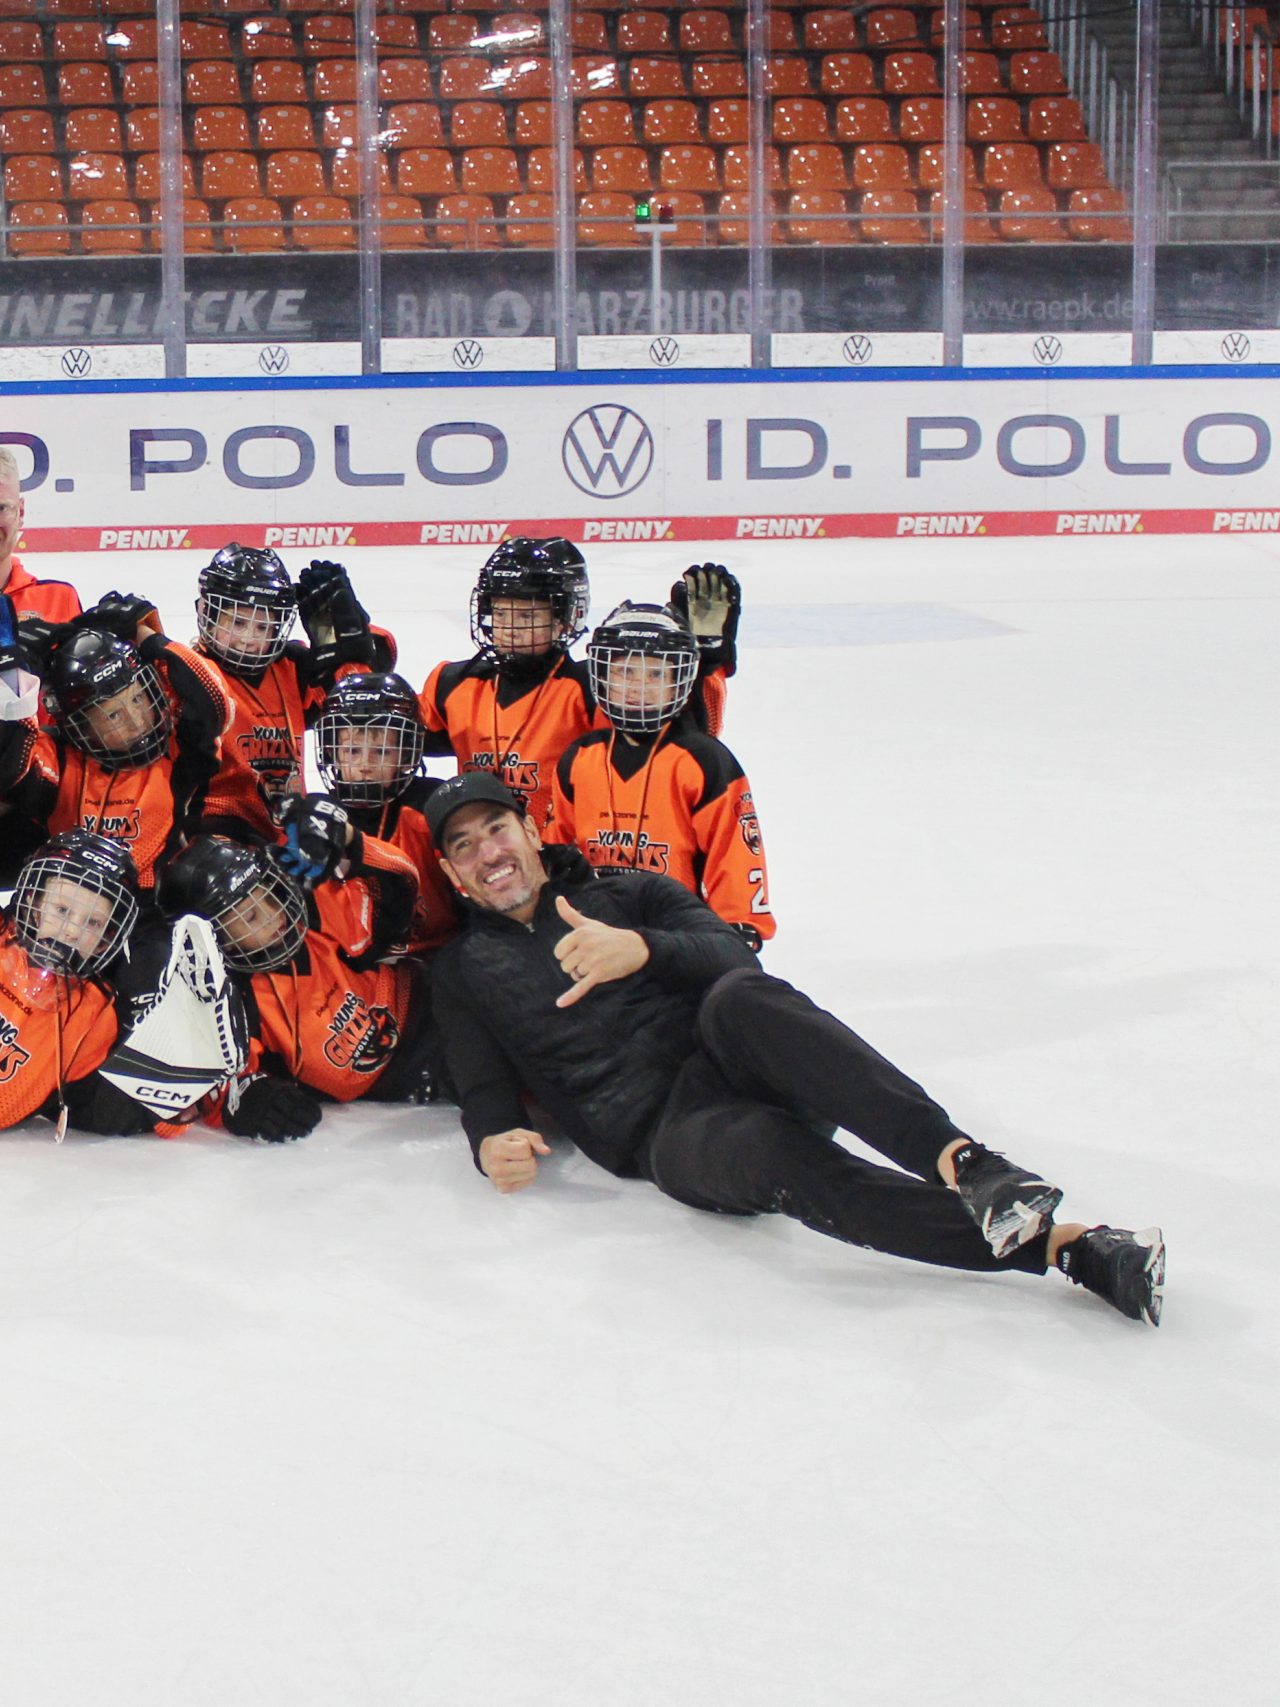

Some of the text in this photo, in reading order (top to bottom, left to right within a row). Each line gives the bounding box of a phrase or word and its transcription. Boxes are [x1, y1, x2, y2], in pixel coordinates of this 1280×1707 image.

[397, 288, 806, 340] BAD HARZBURGER
[129, 421, 509, 492] POLO
[562, 403, 654, 499] VW
[707, 412, 1271, 481] ID. POLO
[246, 586, 278, 595] BAUER
[619, 630, 659, 639] BAUER
[93, 661, 122, 683] CCM
[346, 692, 380, 701] CCM
[82, 849, 120, 872] CCM
[748, 868, 771, 915] 2
[136, 1085, 192, 1104] CCM
